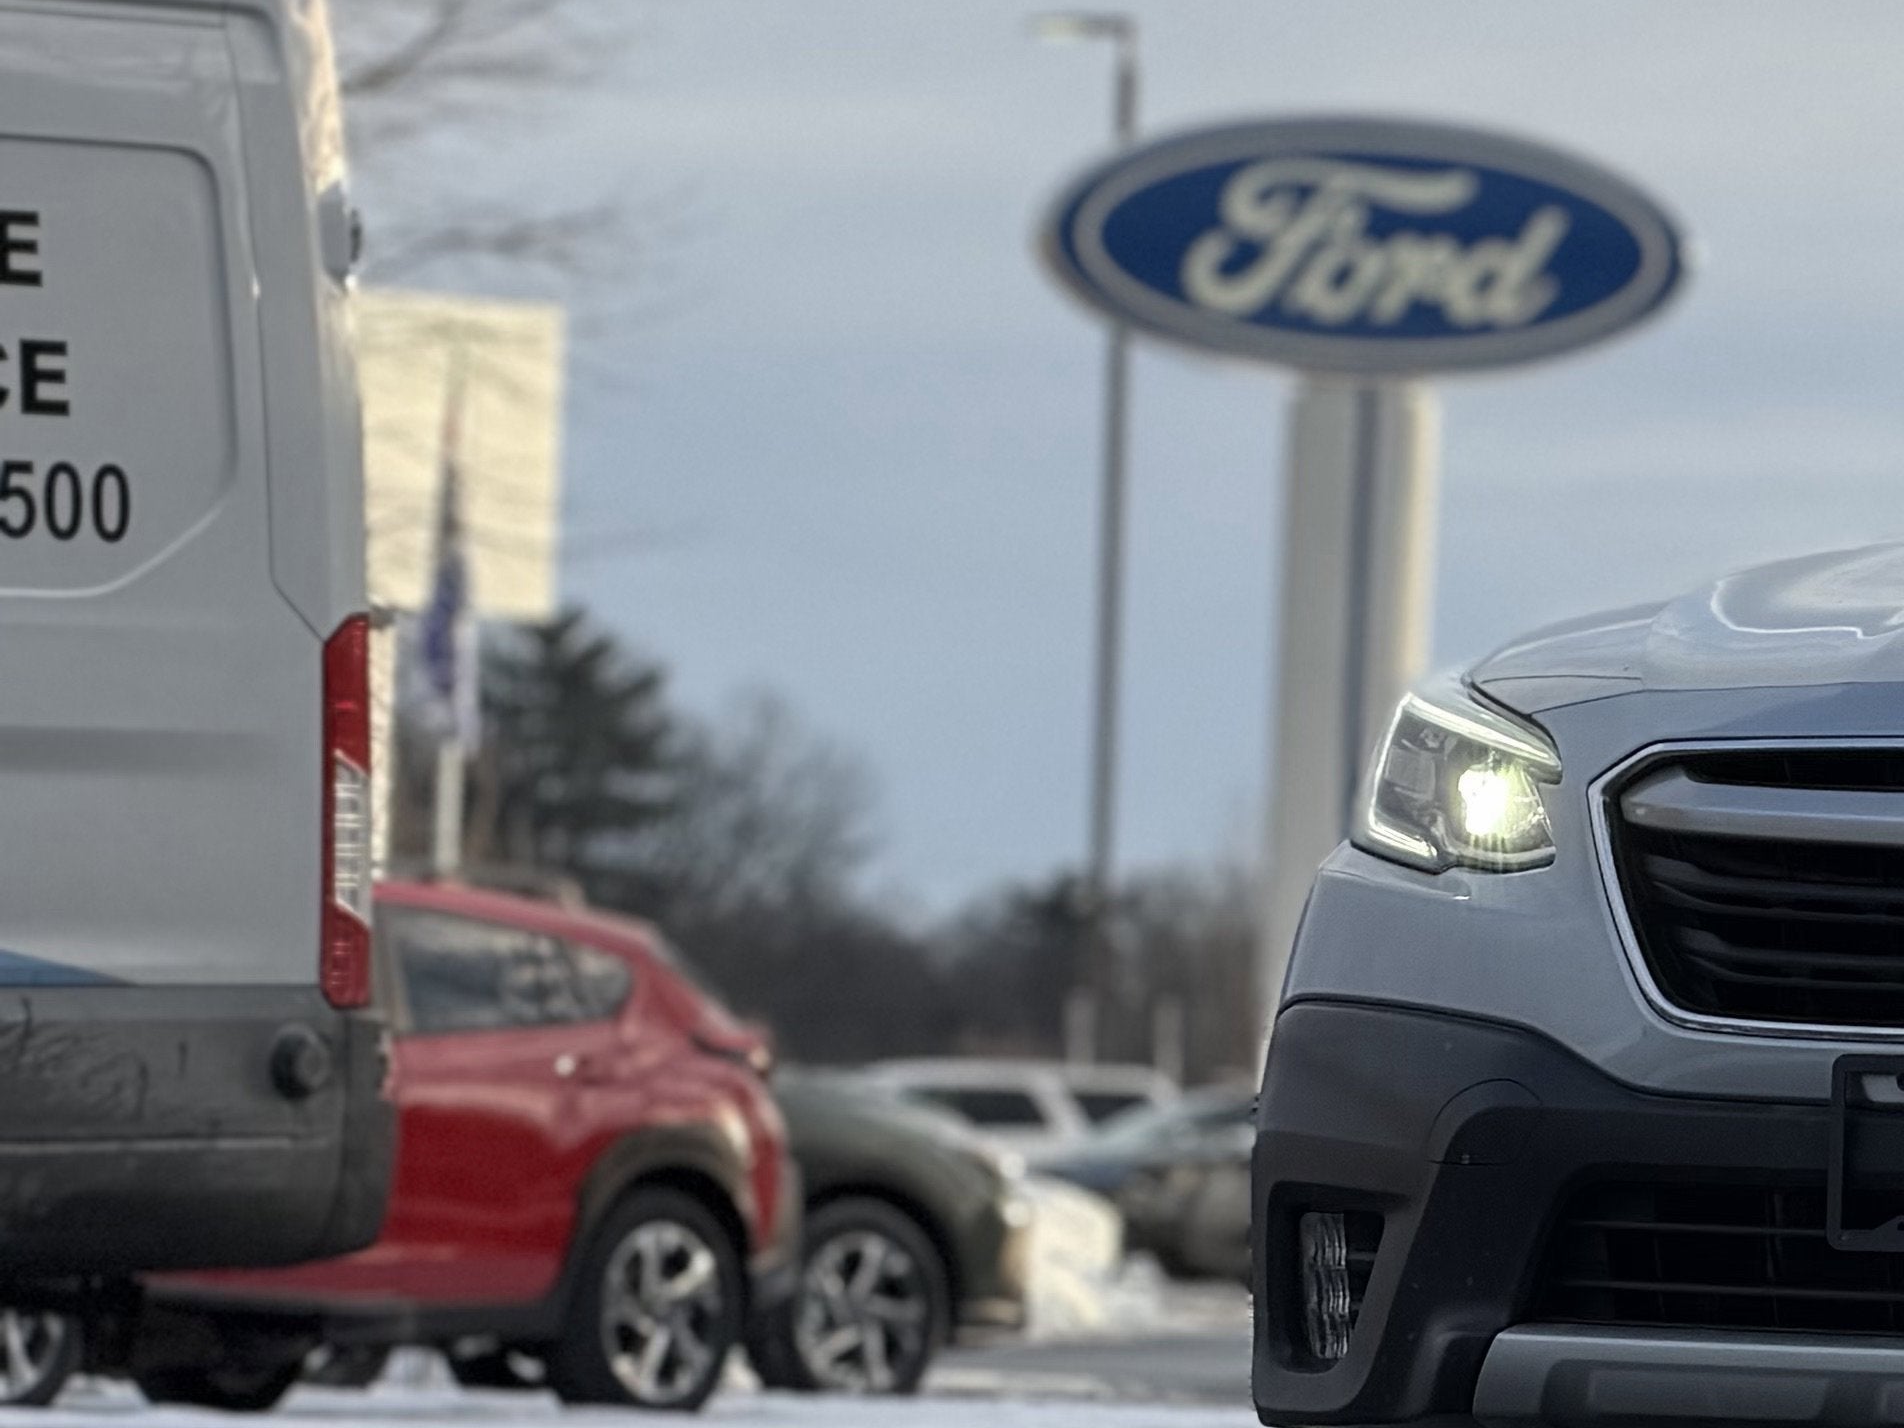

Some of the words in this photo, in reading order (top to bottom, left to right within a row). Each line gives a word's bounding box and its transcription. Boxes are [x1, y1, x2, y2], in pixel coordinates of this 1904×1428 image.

[0, 210, 42, 286] E
[1182, 158, 1569, 326] Ford
[0, 339, 70, 416] E
[0, 461, 130, 543] 500
